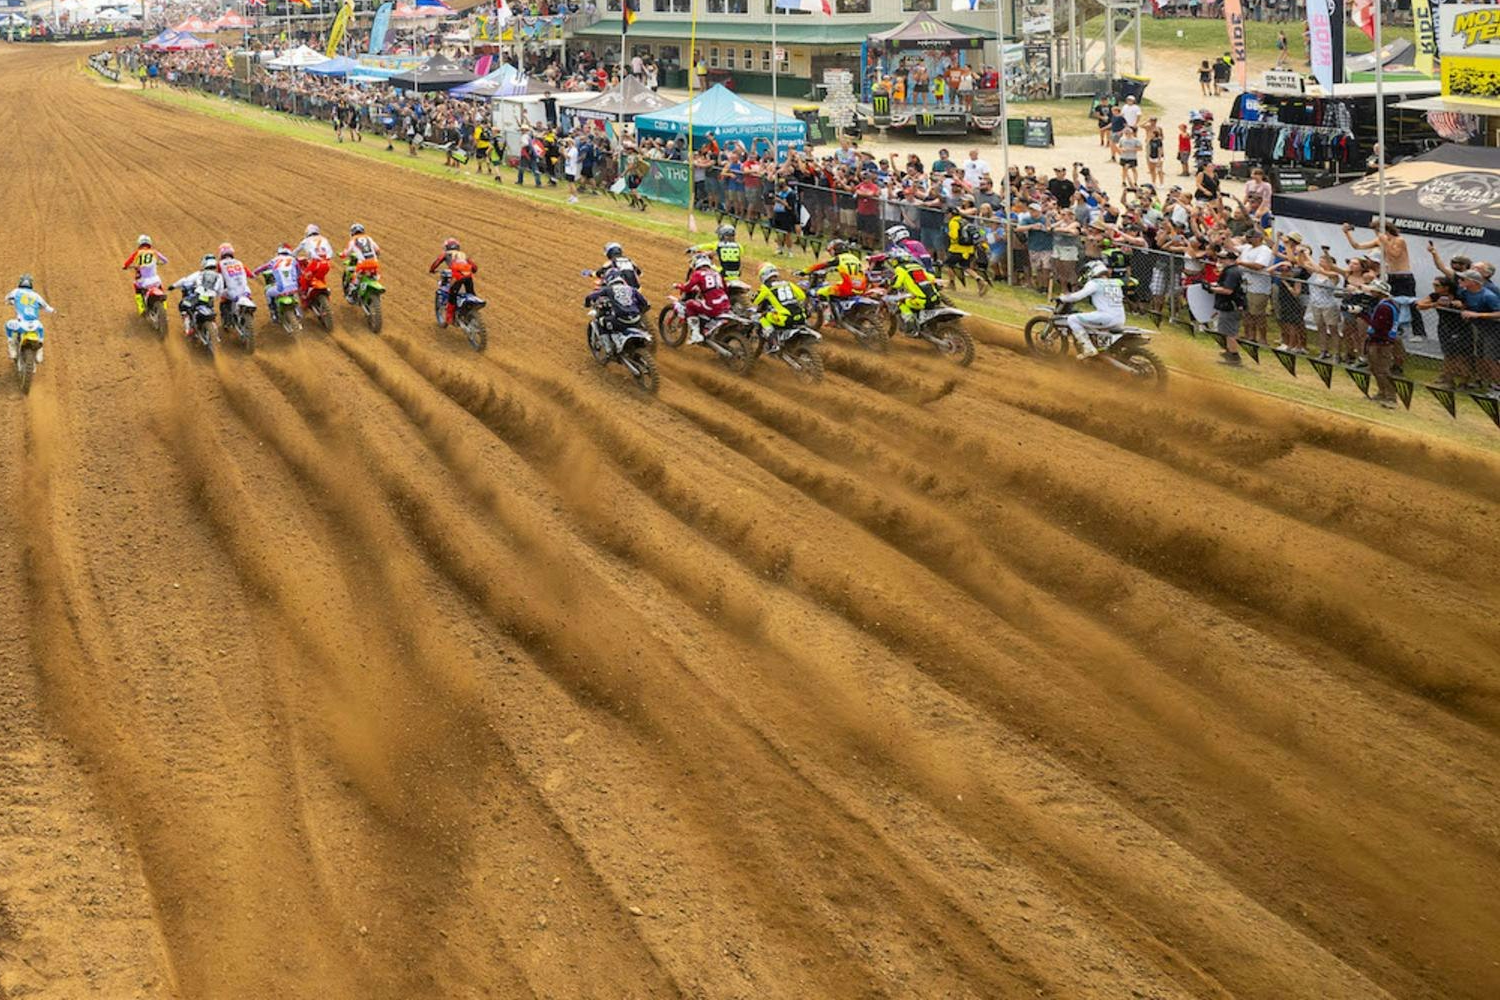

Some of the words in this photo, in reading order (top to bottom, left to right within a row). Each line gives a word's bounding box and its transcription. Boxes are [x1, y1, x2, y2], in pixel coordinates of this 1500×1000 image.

[1465, 23, 1500, 47] TE
[666, 167, 688, 181] THC
[138, 252, 154, 265] 18
